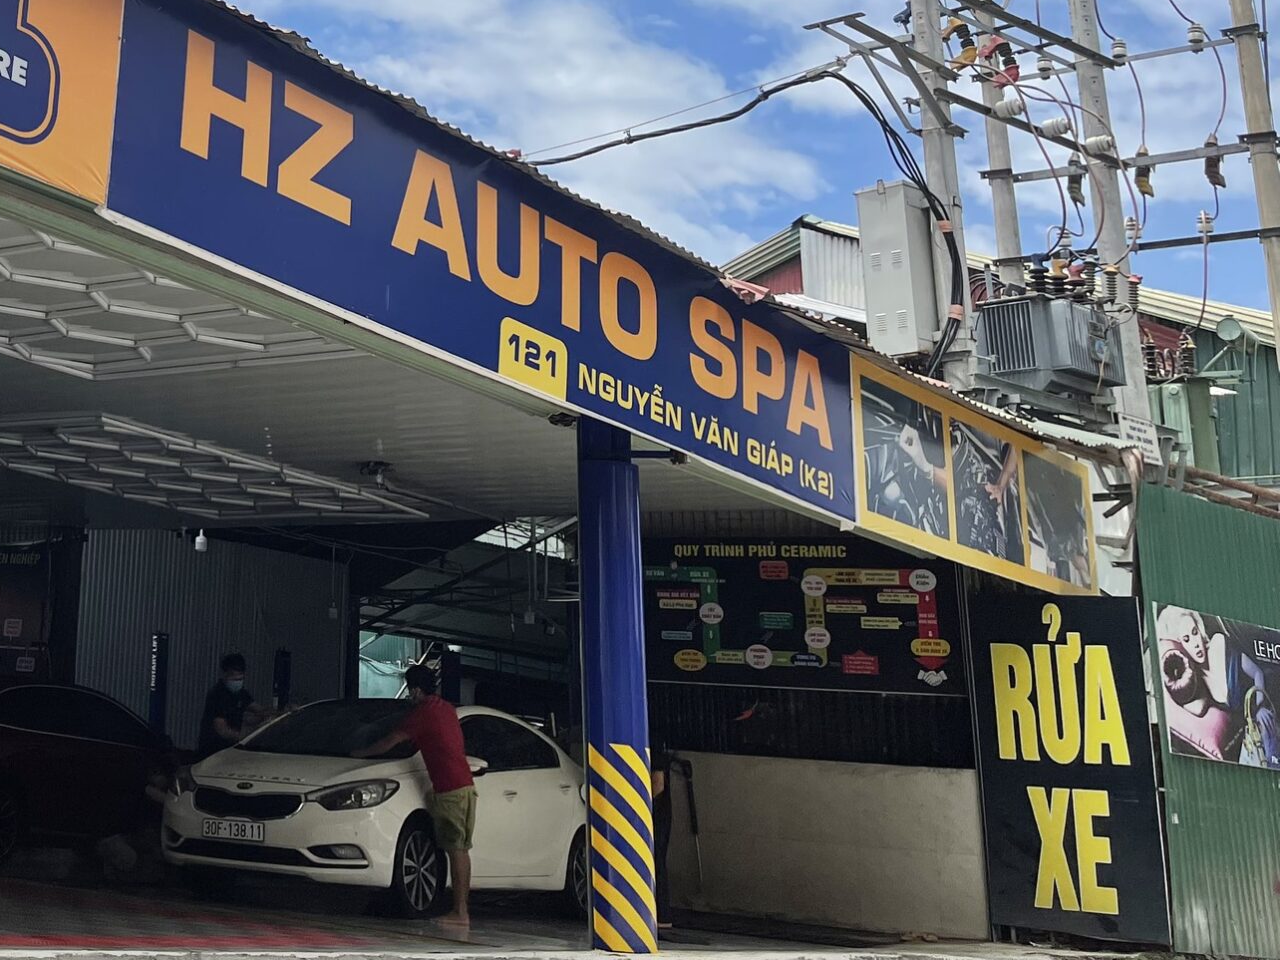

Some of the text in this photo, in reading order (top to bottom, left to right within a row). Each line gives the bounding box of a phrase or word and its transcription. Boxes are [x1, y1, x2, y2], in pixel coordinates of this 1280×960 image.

[180, 29, 833, 452] HZ AUTO SPA
[507, 333, 835, 500] 121 NGUYỄN VĂN GIÁP (K2)
[674, 541, 847, 558] QUY TRÌNH PHỦ CERAMIC
[989, 602, 1131, 766] RỬA
[1026, 786, 1120, 916] XE
